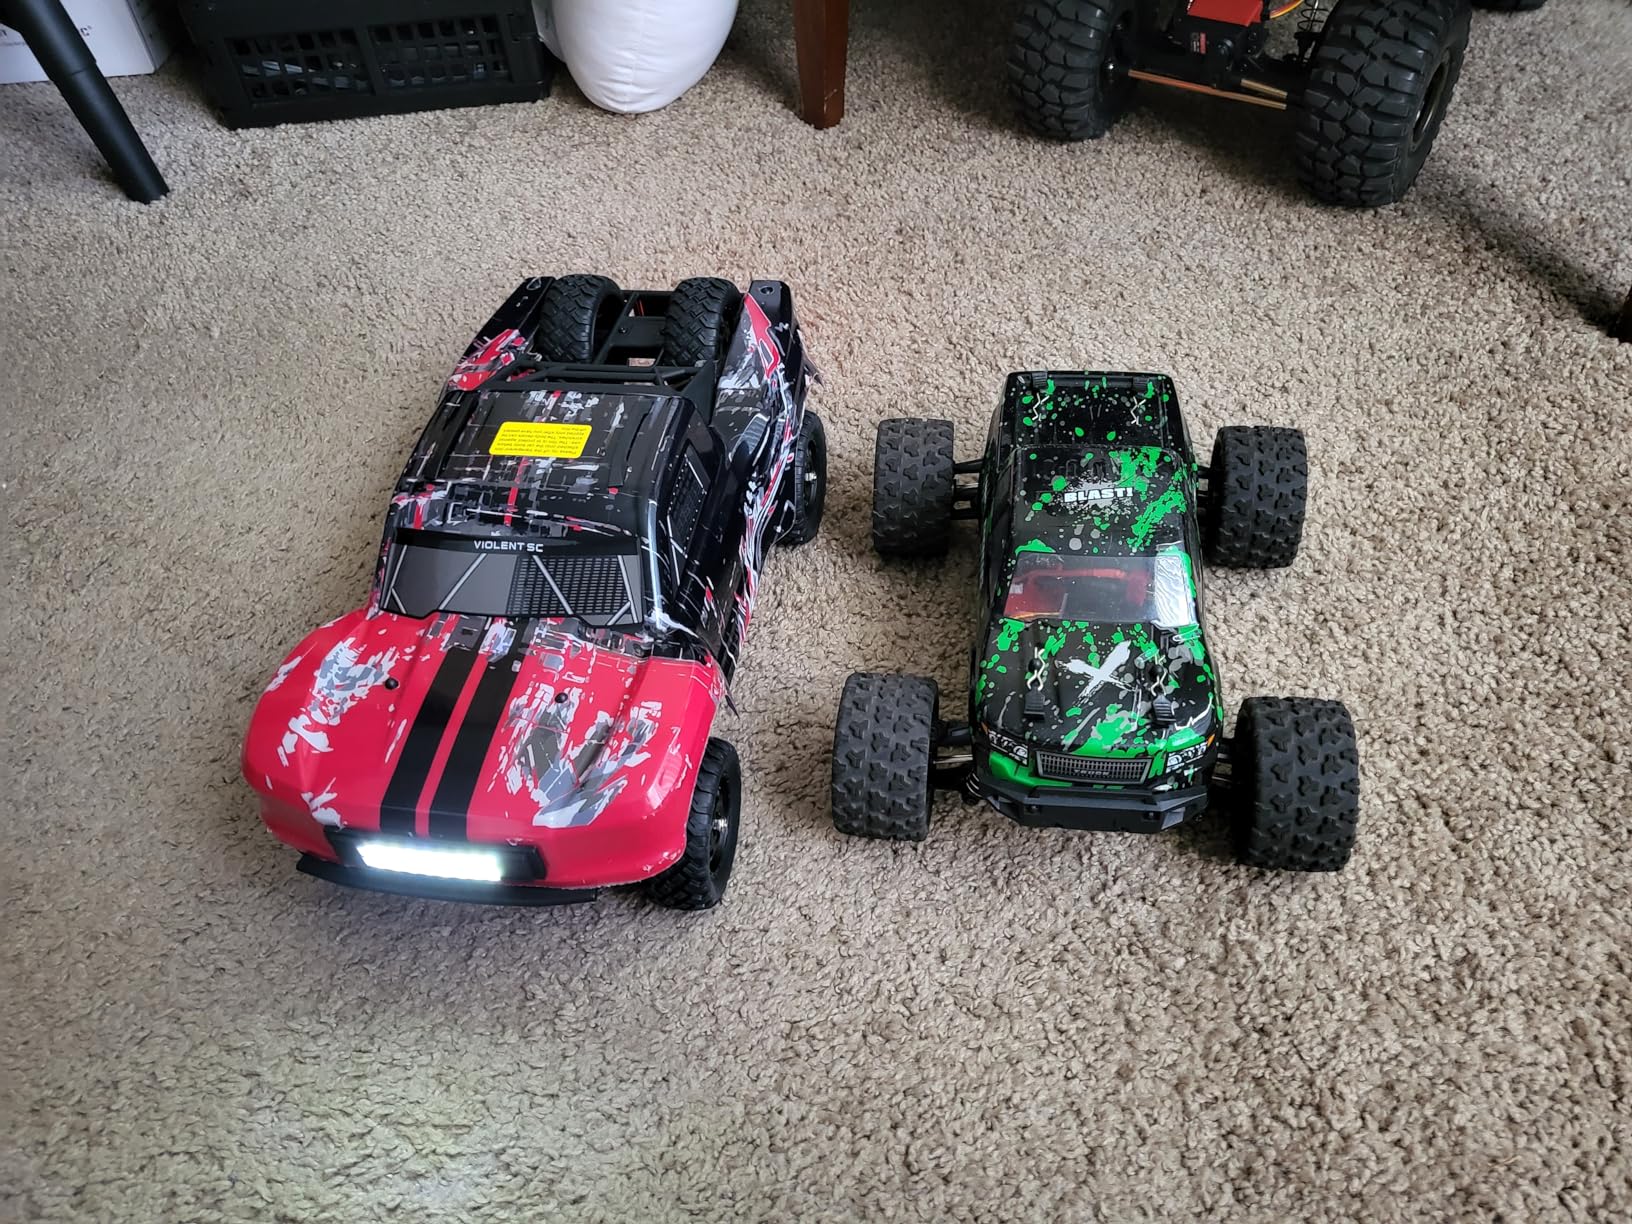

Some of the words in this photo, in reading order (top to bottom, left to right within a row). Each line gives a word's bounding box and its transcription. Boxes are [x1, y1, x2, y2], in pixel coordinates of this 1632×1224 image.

[1064, 487, 1133, 503] BLAST!
[473, 540, 525, 551] VIOLENT
[527, 543, 544, 553] SC
